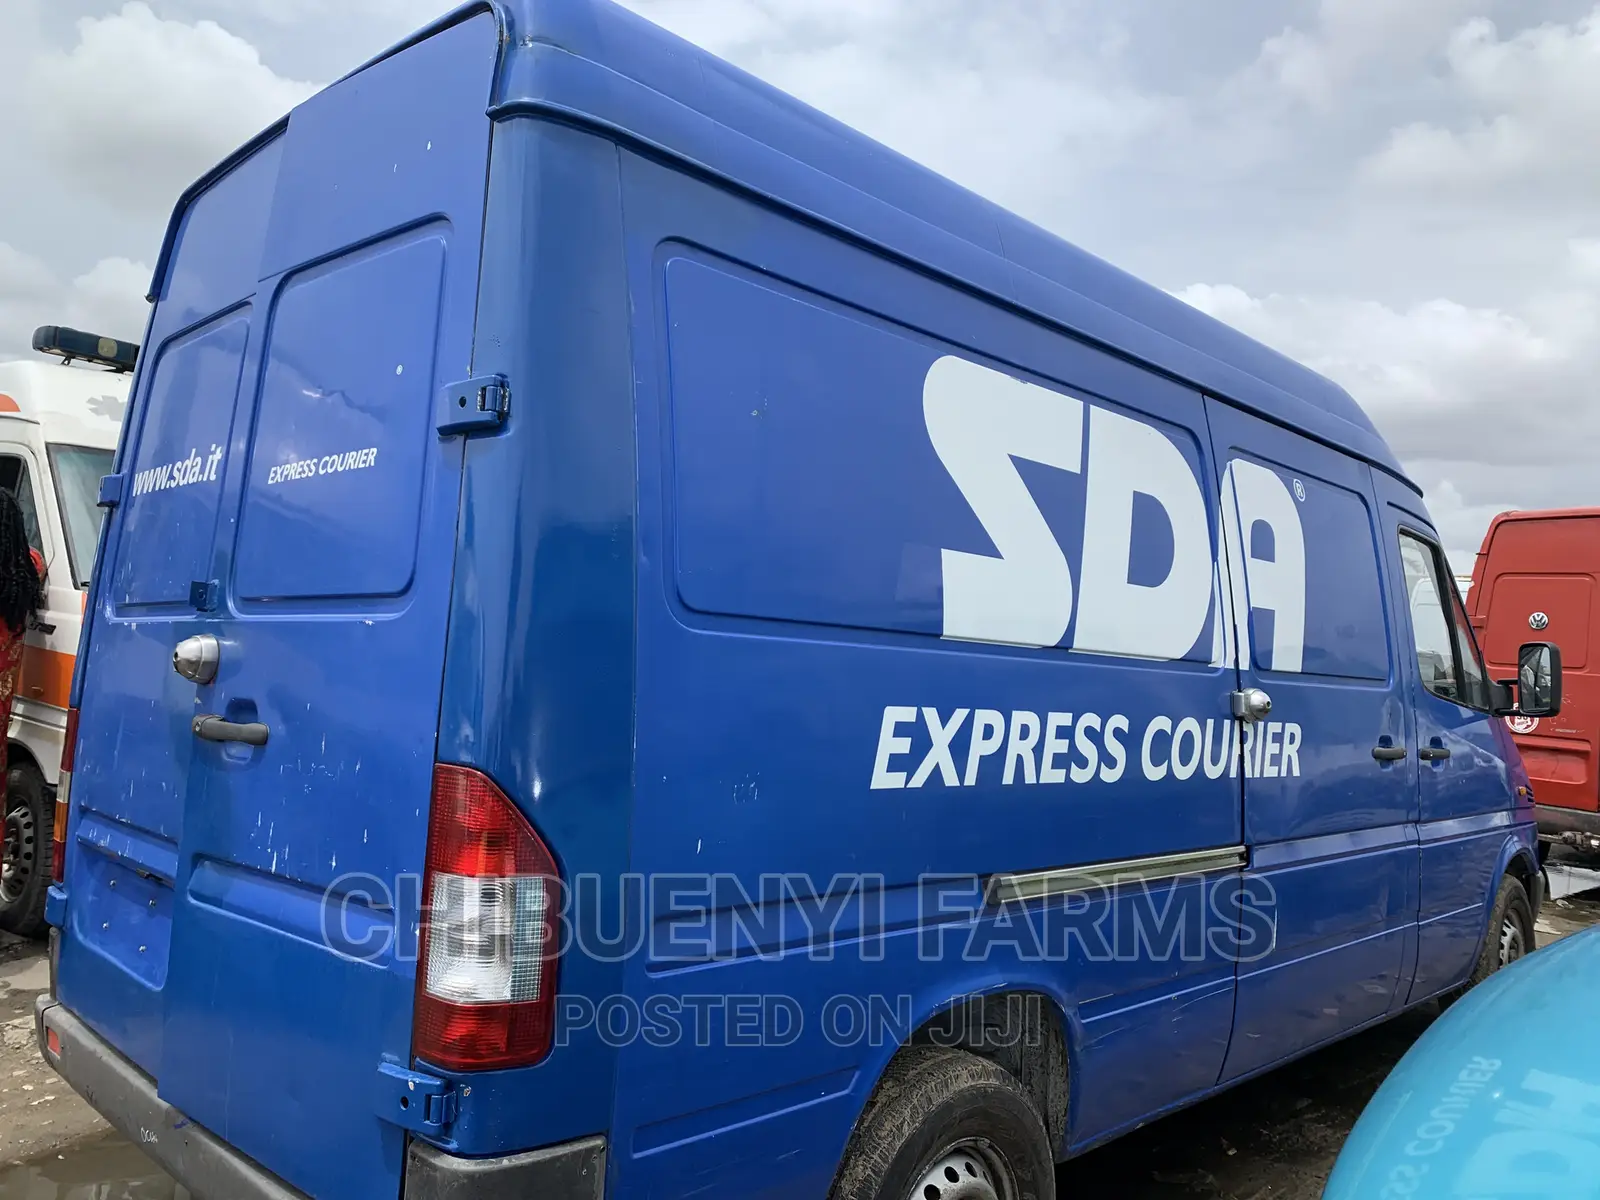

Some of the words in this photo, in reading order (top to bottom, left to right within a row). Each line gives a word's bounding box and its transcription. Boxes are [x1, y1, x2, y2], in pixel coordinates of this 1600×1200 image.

[133, 444, 222, 497] www.sda.it
[267, 457, 318, 485] EXPRESS
[318, 447, 378, 475] COURIER
[923, 355, 1306, 673] SDA
[870, 706, 1129, 790] EXPRESS
[1141, 715, 1303, 782] COURIER
